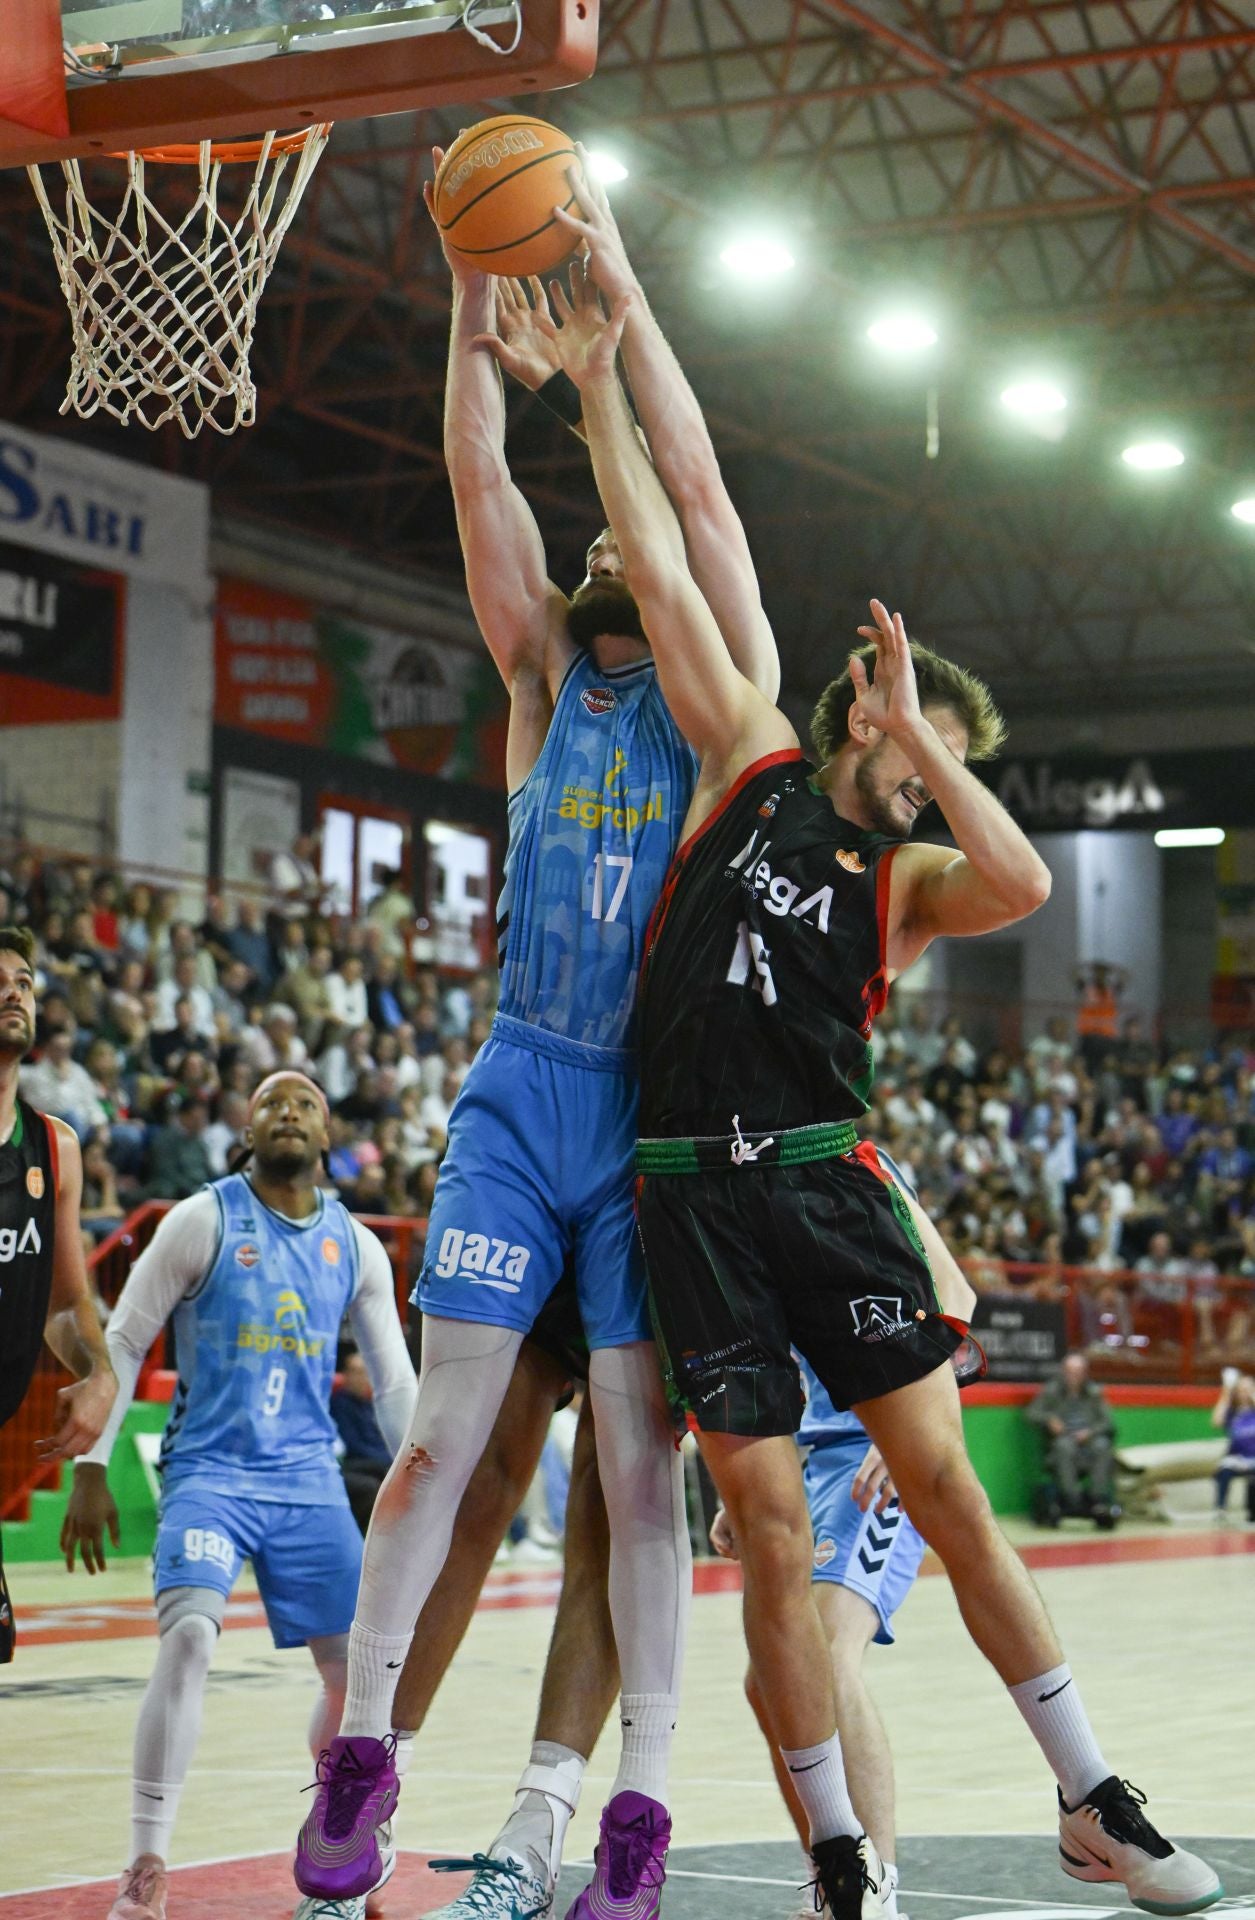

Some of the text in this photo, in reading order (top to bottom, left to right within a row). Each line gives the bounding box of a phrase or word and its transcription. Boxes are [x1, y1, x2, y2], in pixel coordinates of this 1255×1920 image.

[445, 128, 544, 197] Wilson
[584, 692, 617, 708] PALENCIA
[592, 852, 633, 922] 17
[435, 1228, 530, 1283] gaza
[704, 1339, 752, 1362] GOBIERNO
[263, 1368, 287, 1416] 9
